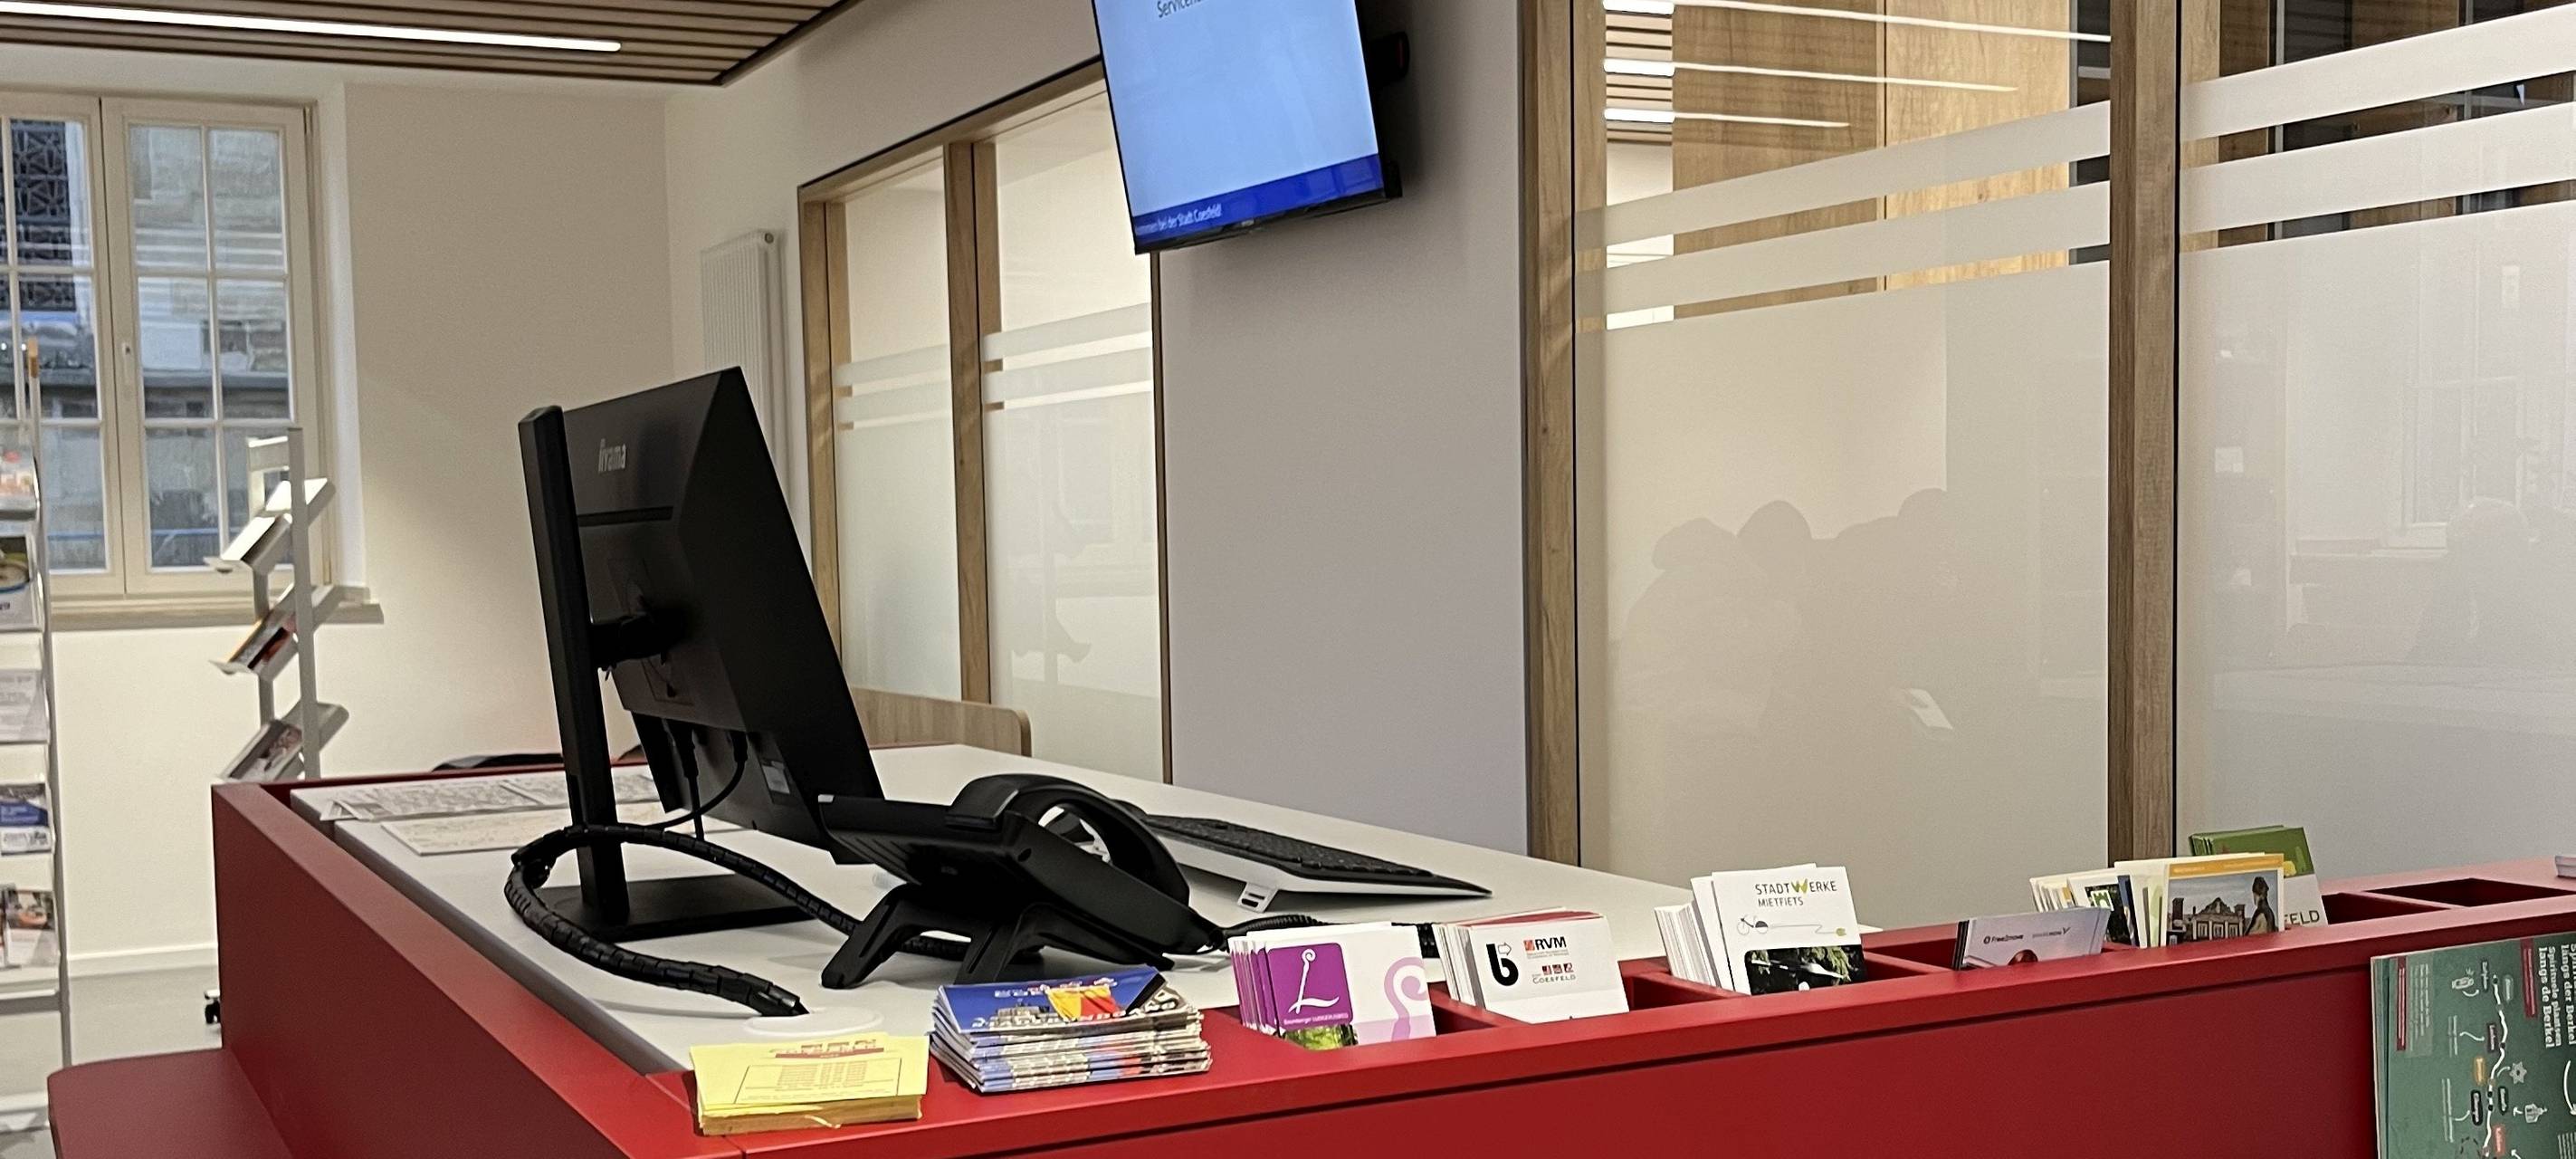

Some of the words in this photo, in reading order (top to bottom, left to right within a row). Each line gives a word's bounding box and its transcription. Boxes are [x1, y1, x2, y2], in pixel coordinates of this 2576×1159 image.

[1758, 896, 1804, 907] MIETFIETS
[1535, 936, 1567, 951] RVM
[2538, 947, 2548, 984] langs
[2542, 986, 2551, 1002] de
[2563, 982, 2572, 1001] der
[2543, 1005, 2555, 1049] Berkel
